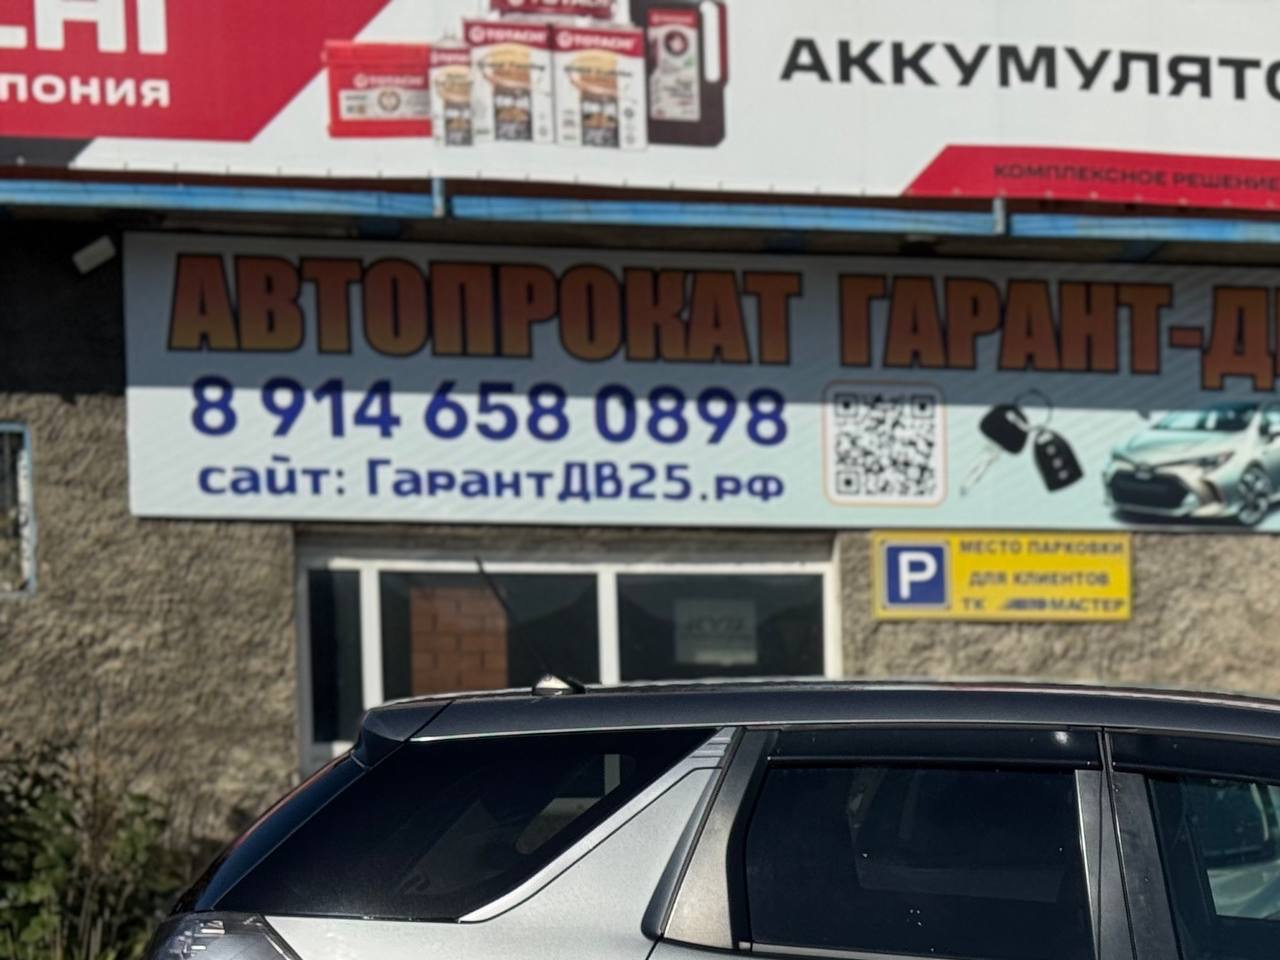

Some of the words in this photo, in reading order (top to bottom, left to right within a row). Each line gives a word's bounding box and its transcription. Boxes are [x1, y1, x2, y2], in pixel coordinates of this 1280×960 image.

[994, 163, 1168, 187] КОМПЛЕКСНОЕ
[1172, 172, 1280, 192] РЕШЕНИЕ
[167, 252, 803, 366] АВТОПРОКАТ
[191, 376, 238, 437] 8
[259, 377, 401, 438] 914
[424, 380, 571, 442] 658
[594, 383, 788, 446] 0898
[199, 454, 345, 496] сайт:
[366, 458, 785, 503] ГарантДВ25.рф
[959, 539, 1022, 555] МЕСТО
[1027, 540, 1124, 556] ПАРКОВКИ
[898, 551, 938, 600] P
[969, 571, 1007, 588] ДЛЯ
[1014, 571, 1110, 587] КЛИЕНТОВ
